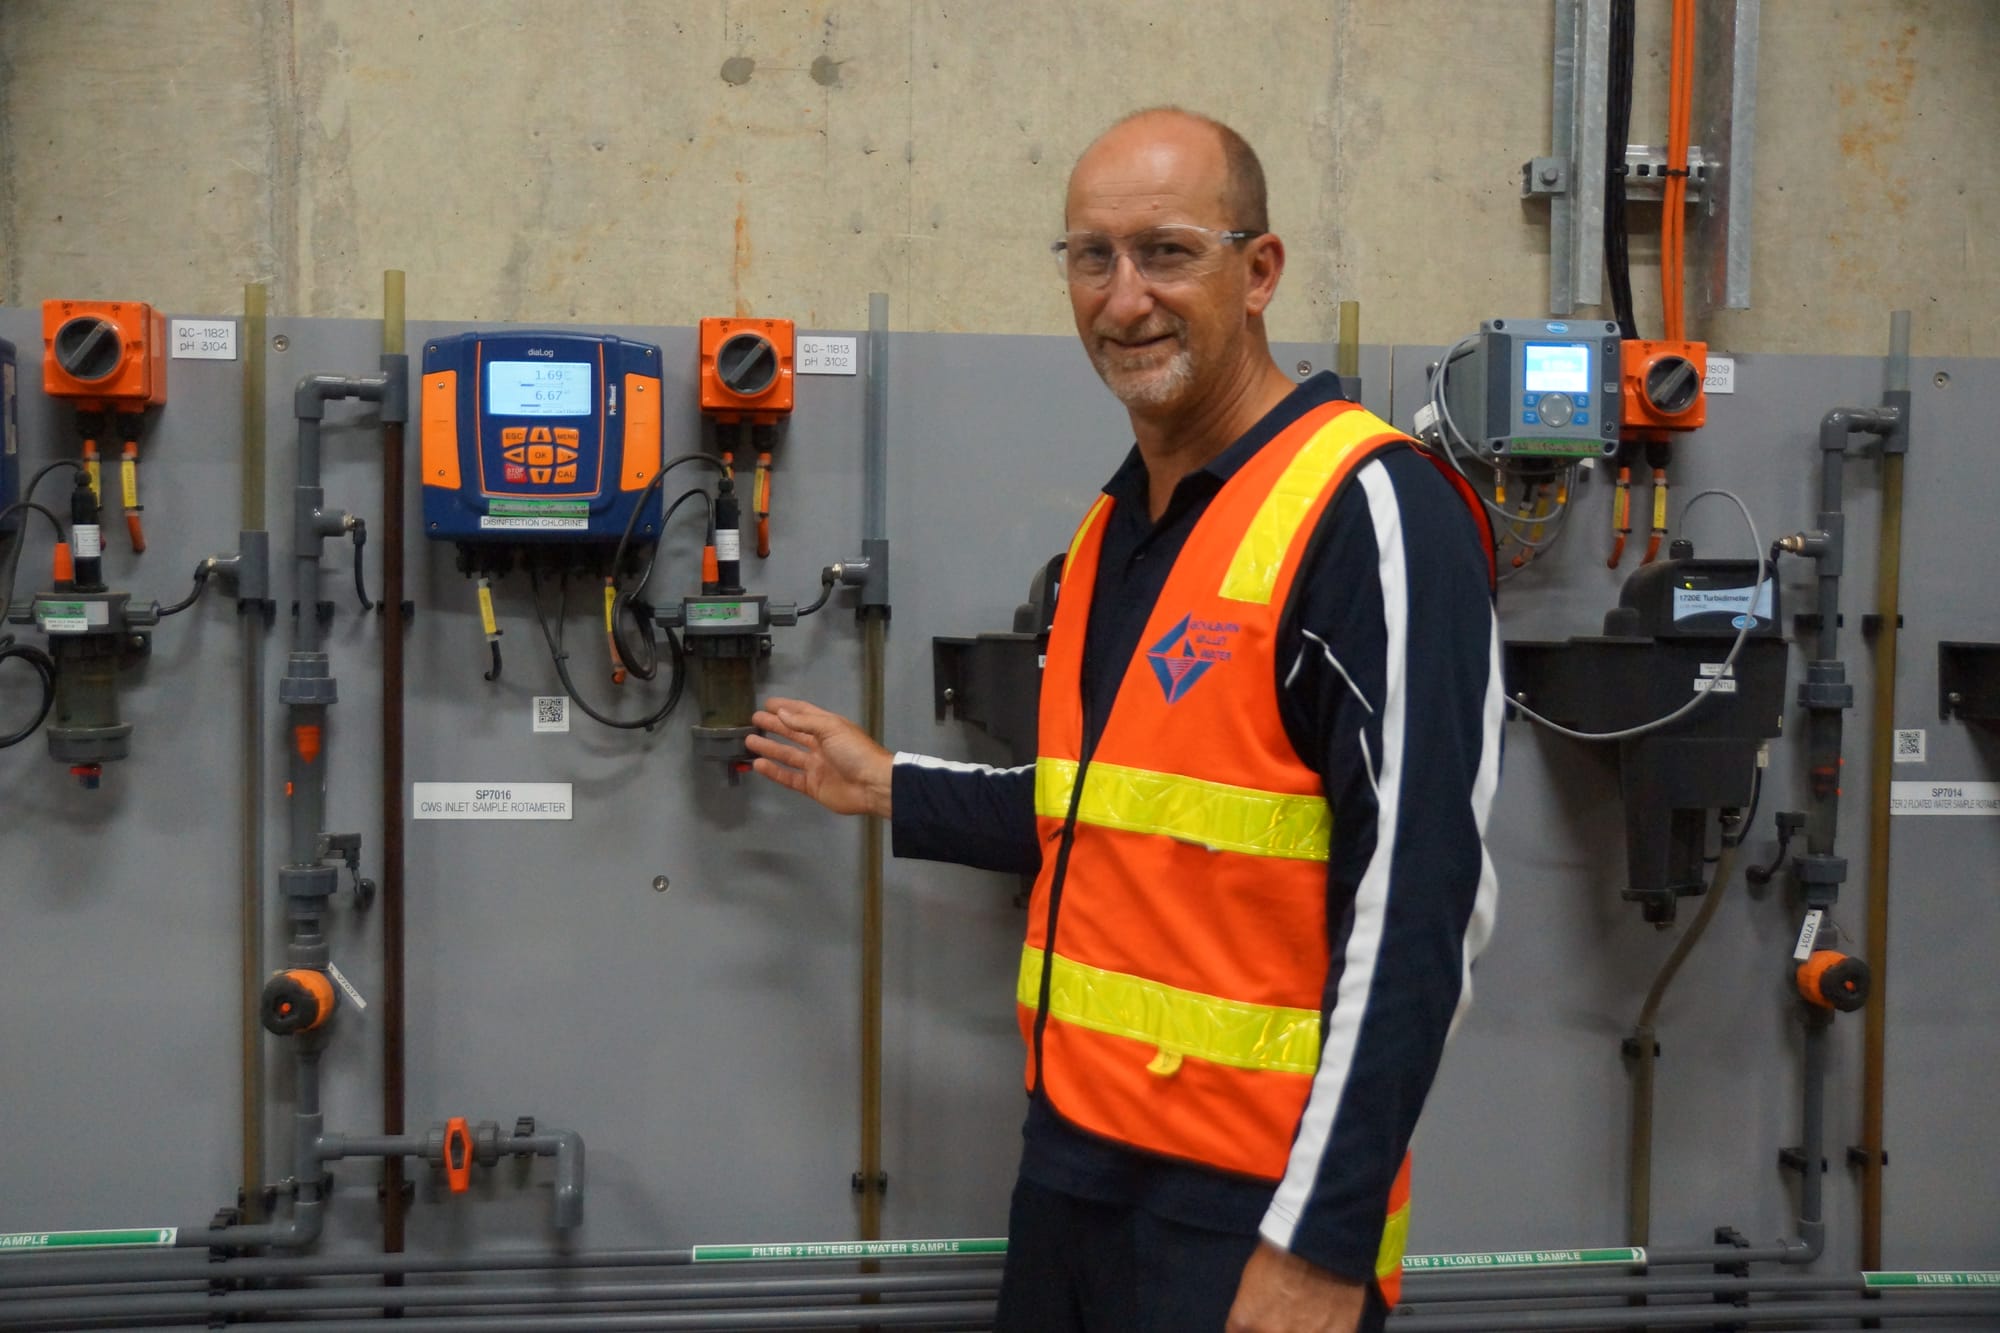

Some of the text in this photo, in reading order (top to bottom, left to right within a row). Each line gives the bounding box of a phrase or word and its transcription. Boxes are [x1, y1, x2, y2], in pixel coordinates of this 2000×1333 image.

[178, 327, 230, 338] QC-11821
[179, 341, 228, 352] pH 3104
[803, 343, 850, 354] QC-11813
[527, 348, 554, 358] diaLog
[804, 356, 848, 368] pH 3102
[535, 370, 563, 380] 1.69
[1705, 377, 1727, 386] 2201
[535, 390, 563, 401] 6.67
[557, 470, 576, 478] CAL
[482, 518, 583, 528] DISINFECTION CHLORINE
[1679, 594, 1701, 602] 1720E
[475, 789, 512, 800] SP7016
[1932, 787, 1962, 798] SP7014
[420, 801, 566, 813] CWS INLET SAMPLE ROTAMETER
[0, 1234, 49, 1247] AMPLE
[752, 1241, 960, 1257] FILTER 2 FILTERED WATER SAMPLE
[1432, 1257, 1440, 1266] 2
[1443, 1255, 1492, 1266] FLOATED
[1495, 1253, 1533, 1264] WATER
[1536, 1251, 1582, 1262] SAMPLE
[1915, 1273, 1953, 1283] FILTER
[1956, 1273, 1962, 1283] 1
